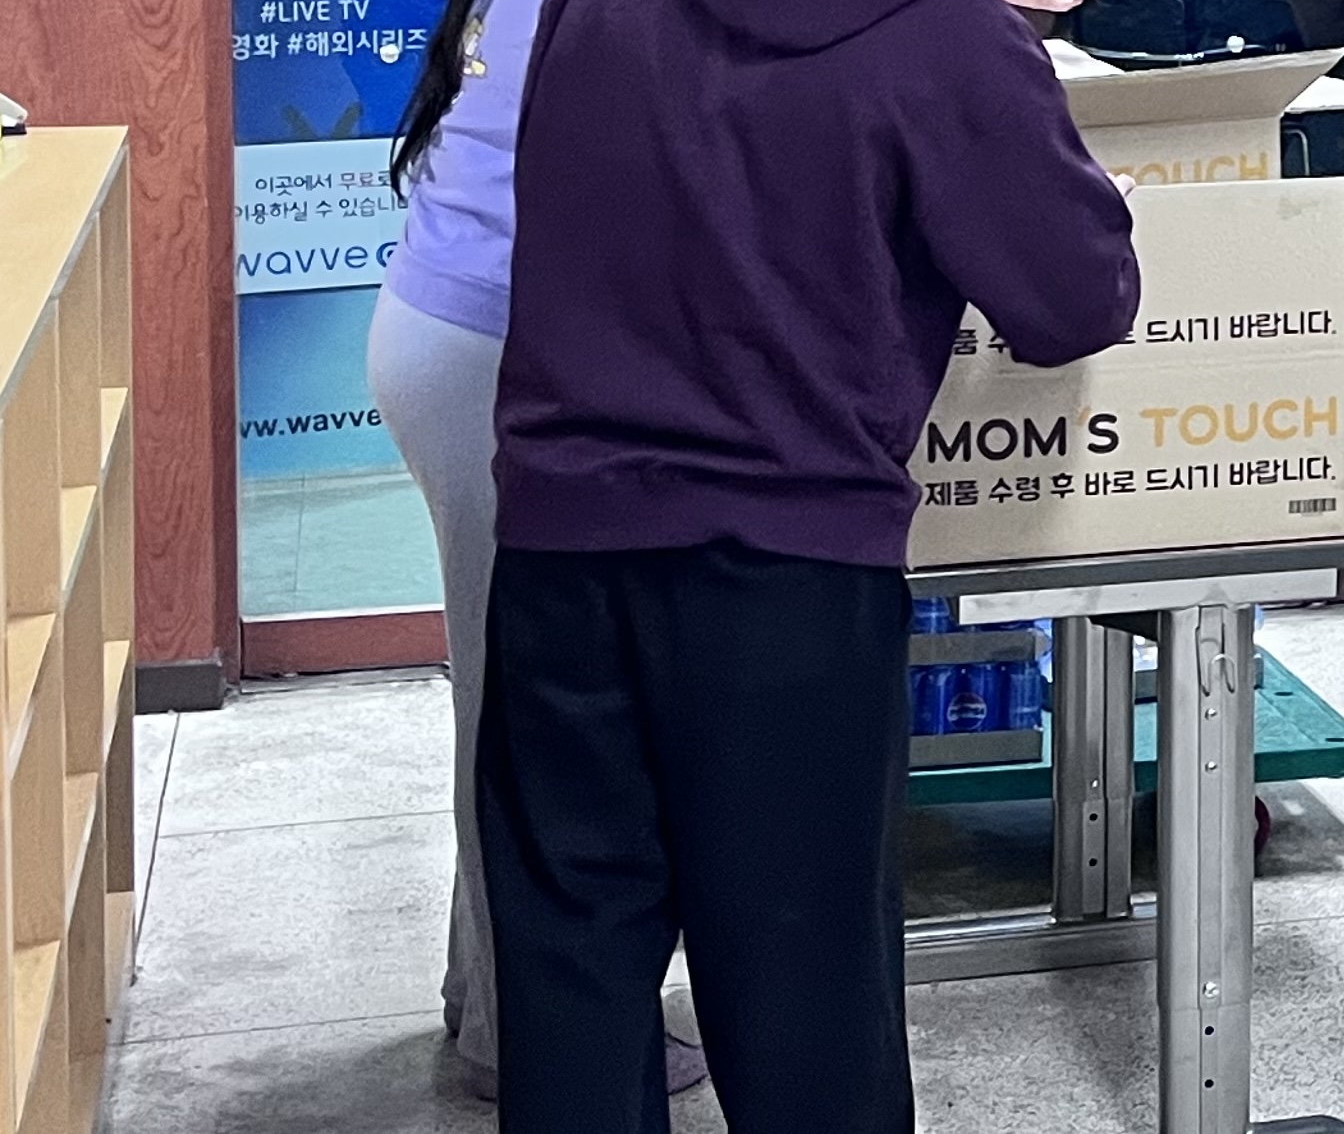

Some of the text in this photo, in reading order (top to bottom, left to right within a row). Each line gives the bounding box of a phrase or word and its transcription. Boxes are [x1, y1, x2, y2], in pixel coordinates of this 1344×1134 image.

[260, 0, 331, 23] #LIVE
[287, 28, 428, 57] #해외시리즈
[255, 172, 332, 196] 이곳에서
[315, 200, 333, 217] 수
[1145, 317, 1219, 344] 드시기
[1230, 310, 1337, 340] 바랍니다.
[1140, 396, 1338, 448] TOUCH
[924, 456, 1337, 507] 제품 수령 후 바로 드시기 바랍니다.
